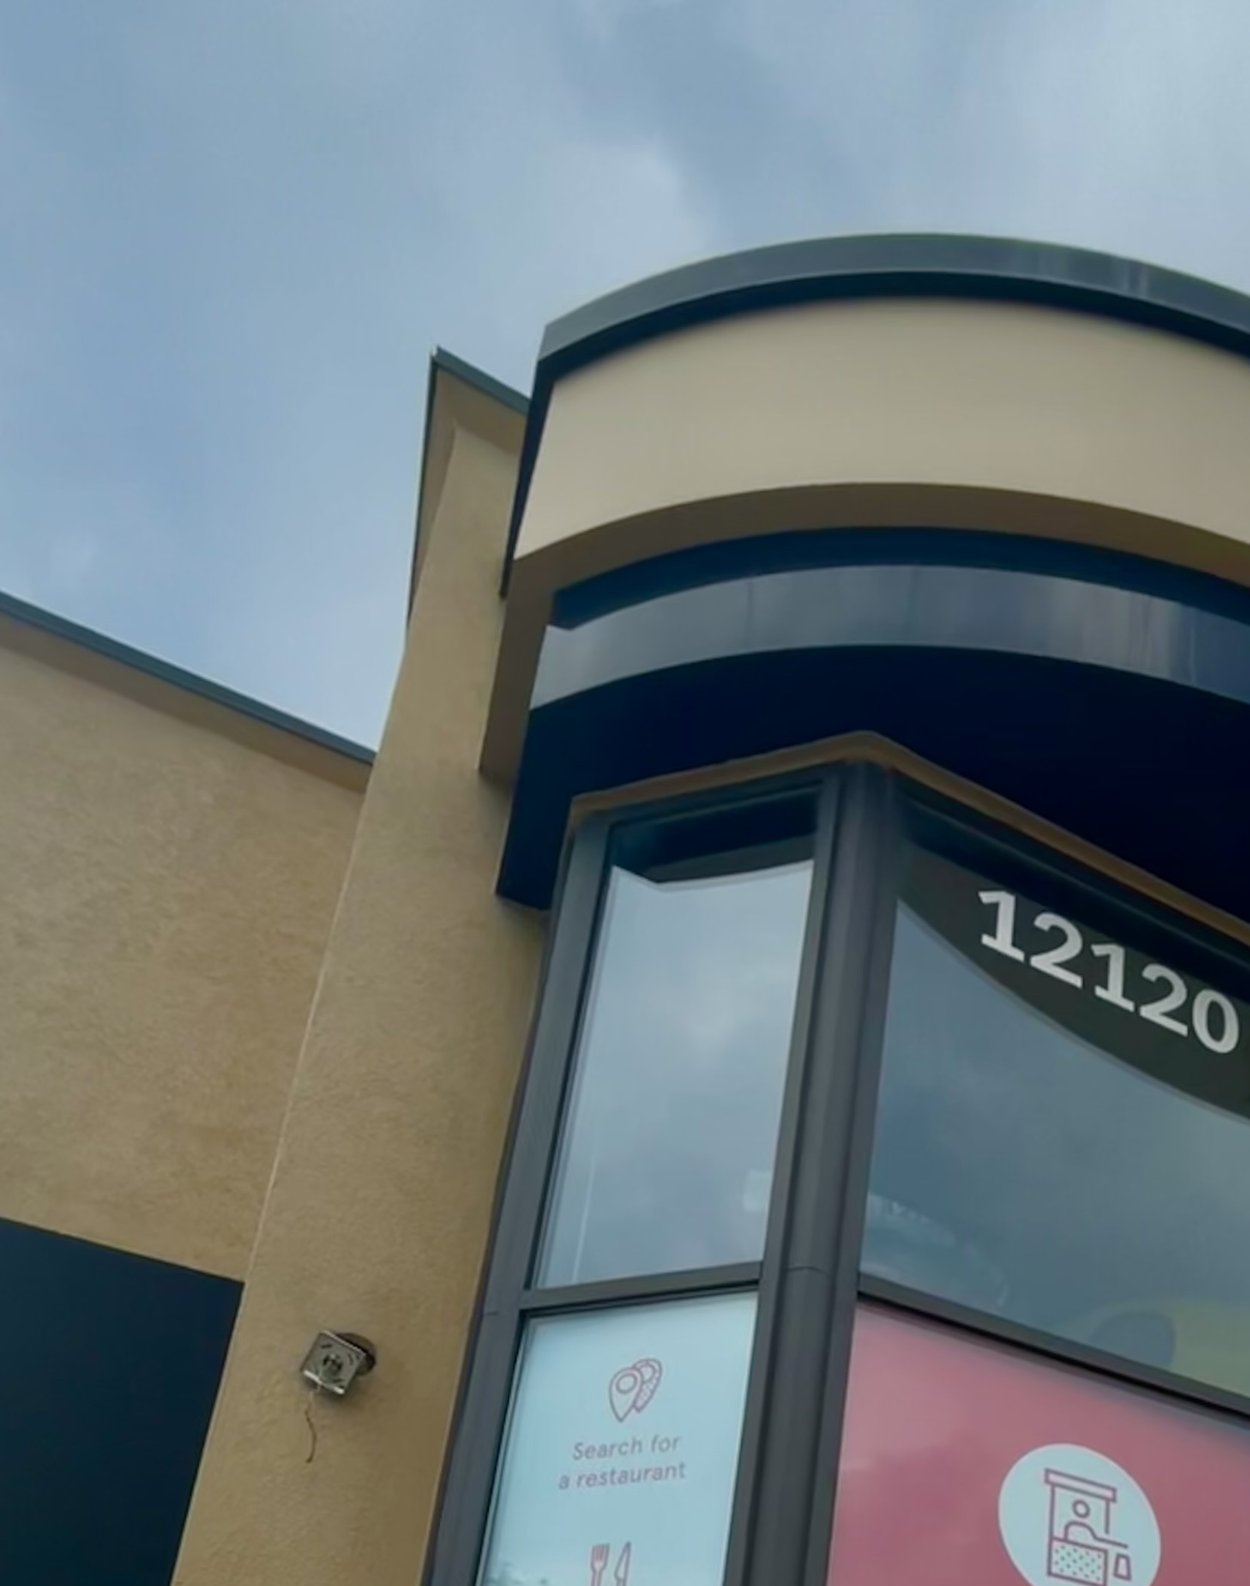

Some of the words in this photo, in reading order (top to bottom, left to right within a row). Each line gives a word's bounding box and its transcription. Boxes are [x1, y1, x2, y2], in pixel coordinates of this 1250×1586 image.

[978, 890, 1239, 1054] 12120
[572, 1437, 643, 1461] Search
[651, 1434, 681, 1453] for
[559, 1474, 570, 1490] a
[576, 1462, 686, 1489] restaurant
